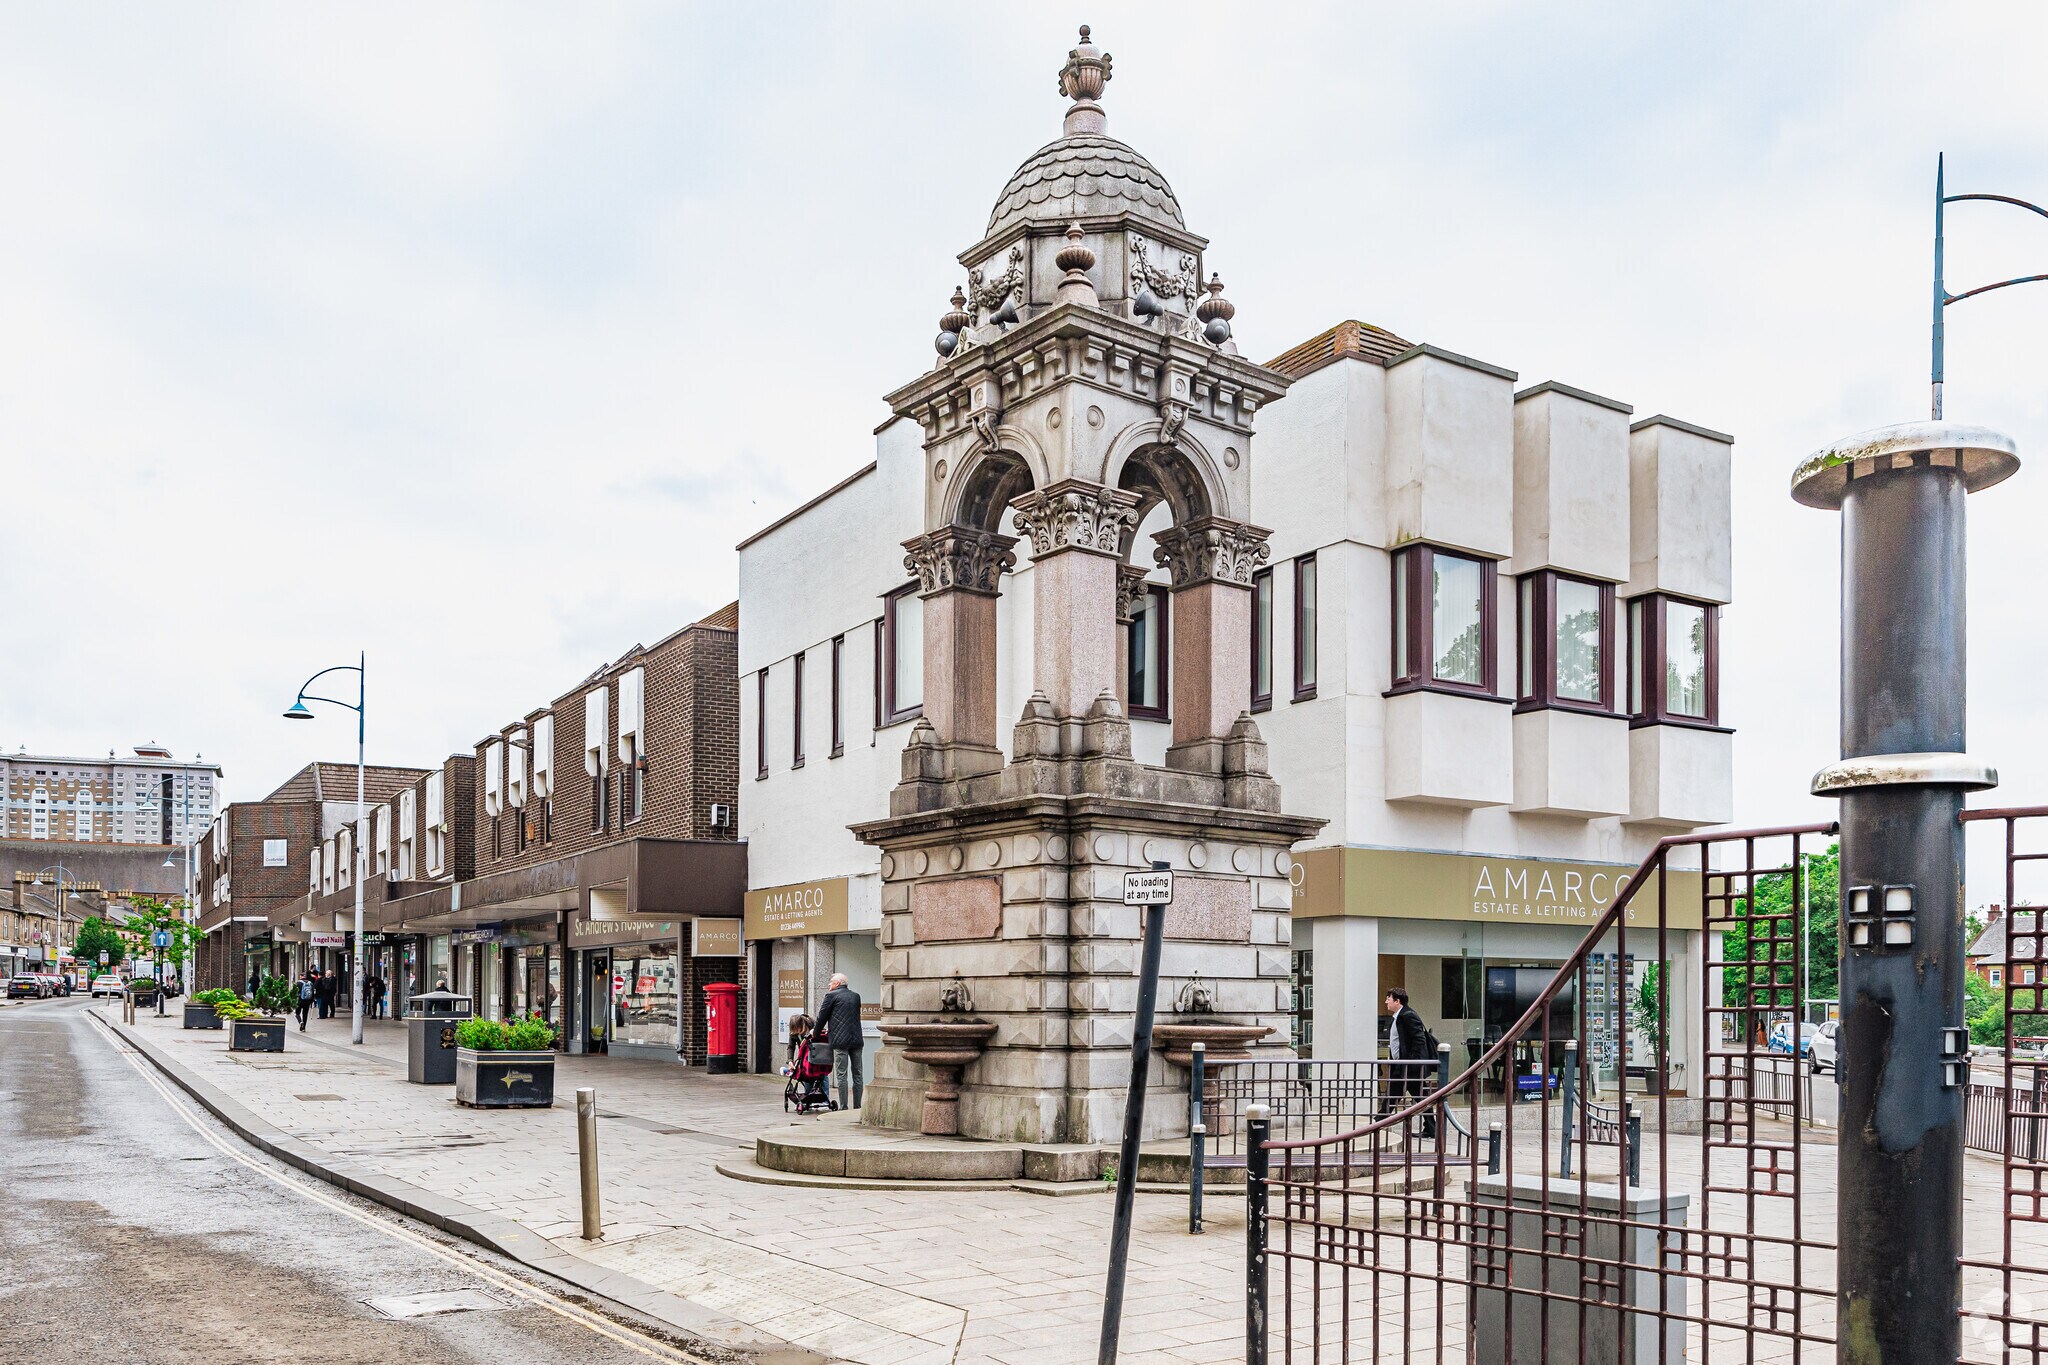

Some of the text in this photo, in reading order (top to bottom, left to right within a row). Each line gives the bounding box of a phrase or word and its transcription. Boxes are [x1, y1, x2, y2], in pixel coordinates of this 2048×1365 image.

[1128, 876, 1169, 887] No loading
[1126, 889, 1169, 900] at any time
[764, 888, 823, 913] AMARCO
[764, 913, 780, 921] ESTATE
[785, 911, 804, 919] LETTING
[804, 908, 823, 917] AGENTS
[1474, 902, 1518, 914] ESTATE
[1525, 904, 1532, 915] &
[1537, 905, 1586, 918] LETTING
[313, 936, 329, 944] Angel
[780, 979, 804, 989] AMARC
